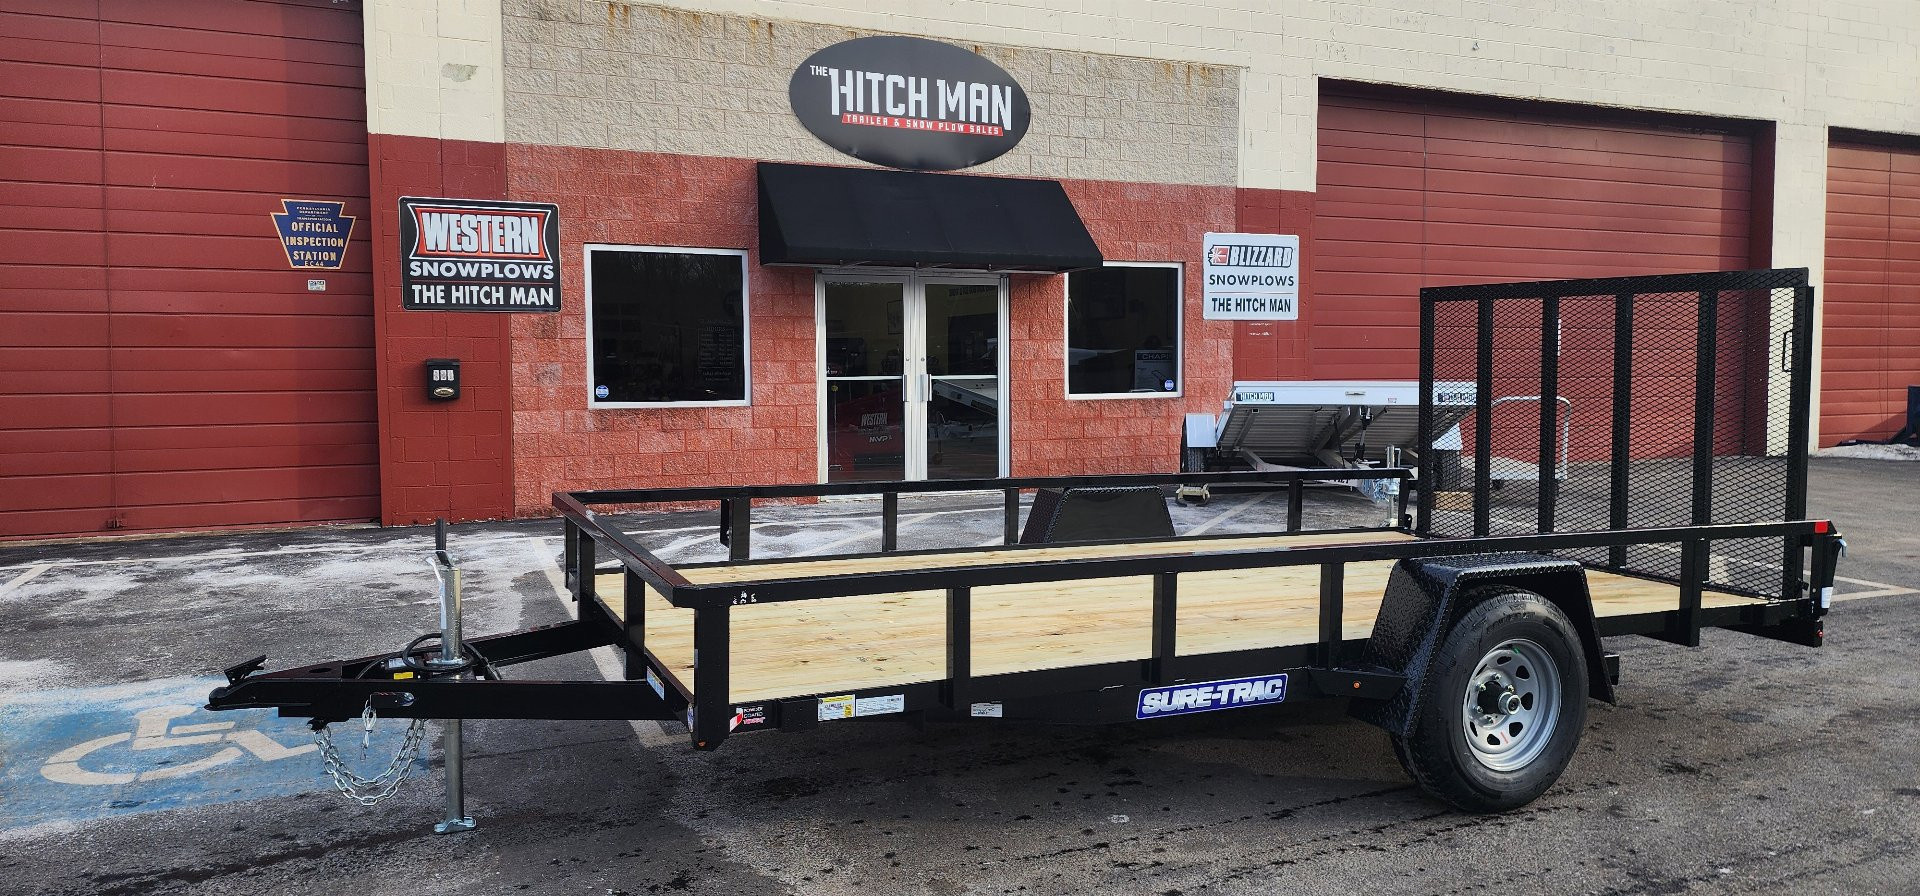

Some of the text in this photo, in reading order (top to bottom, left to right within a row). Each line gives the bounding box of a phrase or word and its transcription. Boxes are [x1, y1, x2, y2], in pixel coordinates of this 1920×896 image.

[810, 65, 828, 77] THE
[828, 68, 1012, 131] HITCH MAN
[846, 114, 999, 136] TRAILER & SNOW PLOW SALES
[291, 222, 339, 233] OFFICIAL
[421, 212, 540, 255] WESTERN
[285, 236, 344, 248] INSPECTION
[293, 250, 337, 261] STATION
[1229, 246, 1293, 267] BLIZZARD
[409, 261, 555, 280] SNOWPLOWS
[1208, 274, 1295, 287] SNOWPLOWS
[412, 284, 554, 306] THE HITCH MAN
[1211, 297, 1291, 312] THE HITCH MAN
[1141, 678, 1283, 715] SURE-TRAC
